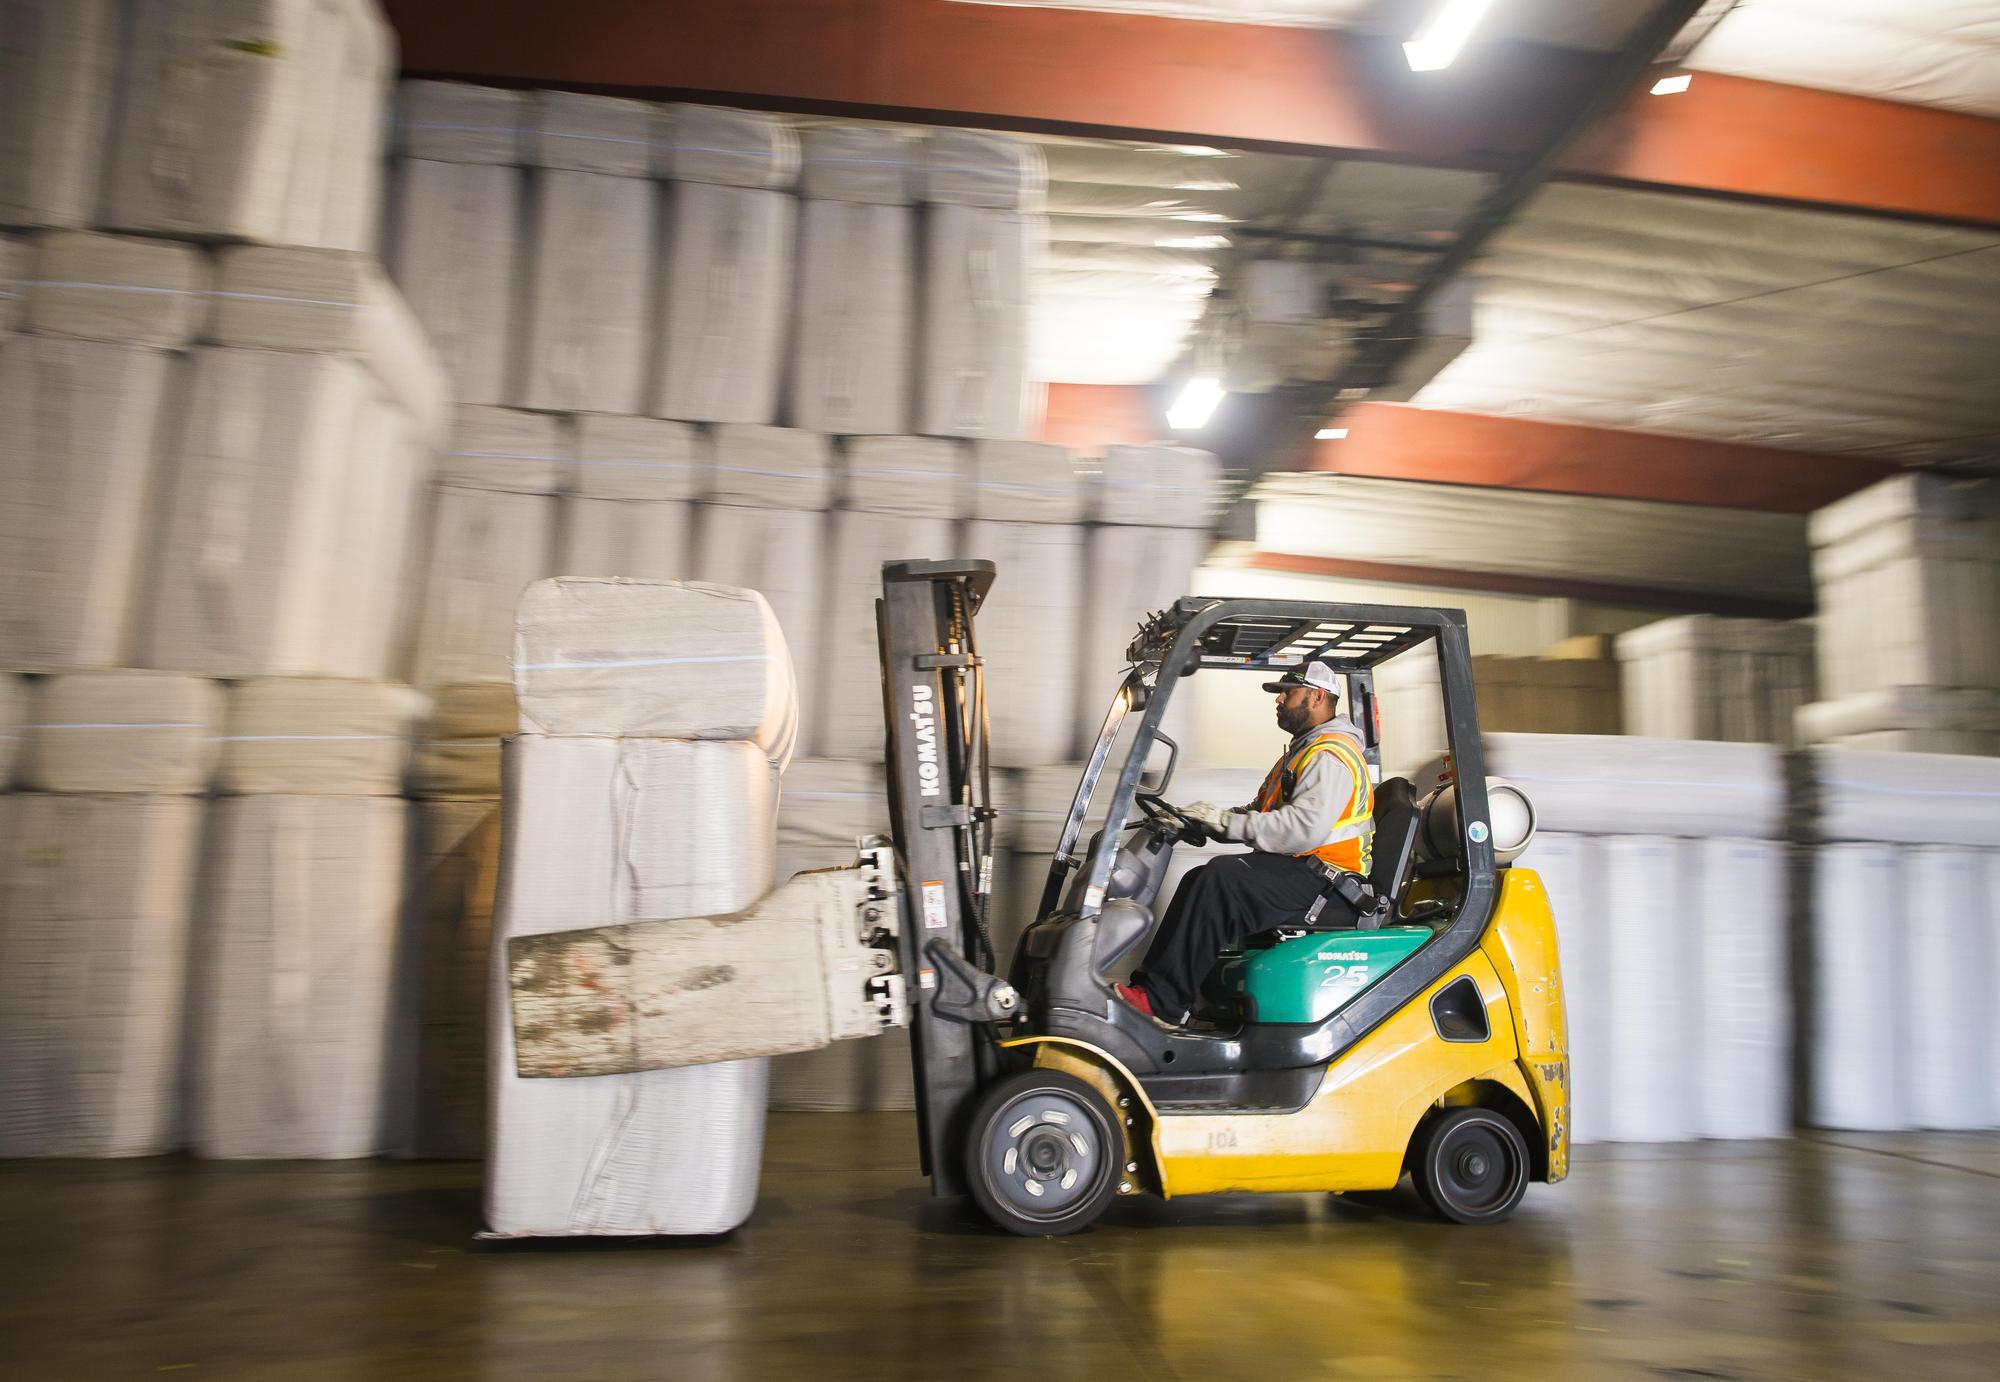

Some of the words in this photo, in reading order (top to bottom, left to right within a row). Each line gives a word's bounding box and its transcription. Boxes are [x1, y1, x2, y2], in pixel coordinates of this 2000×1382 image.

[910, 685, 940, 797] KOMATSU
[1317, 950, 1369, 961] KOMATSU
[1319, 965, 1369, 987] 25
